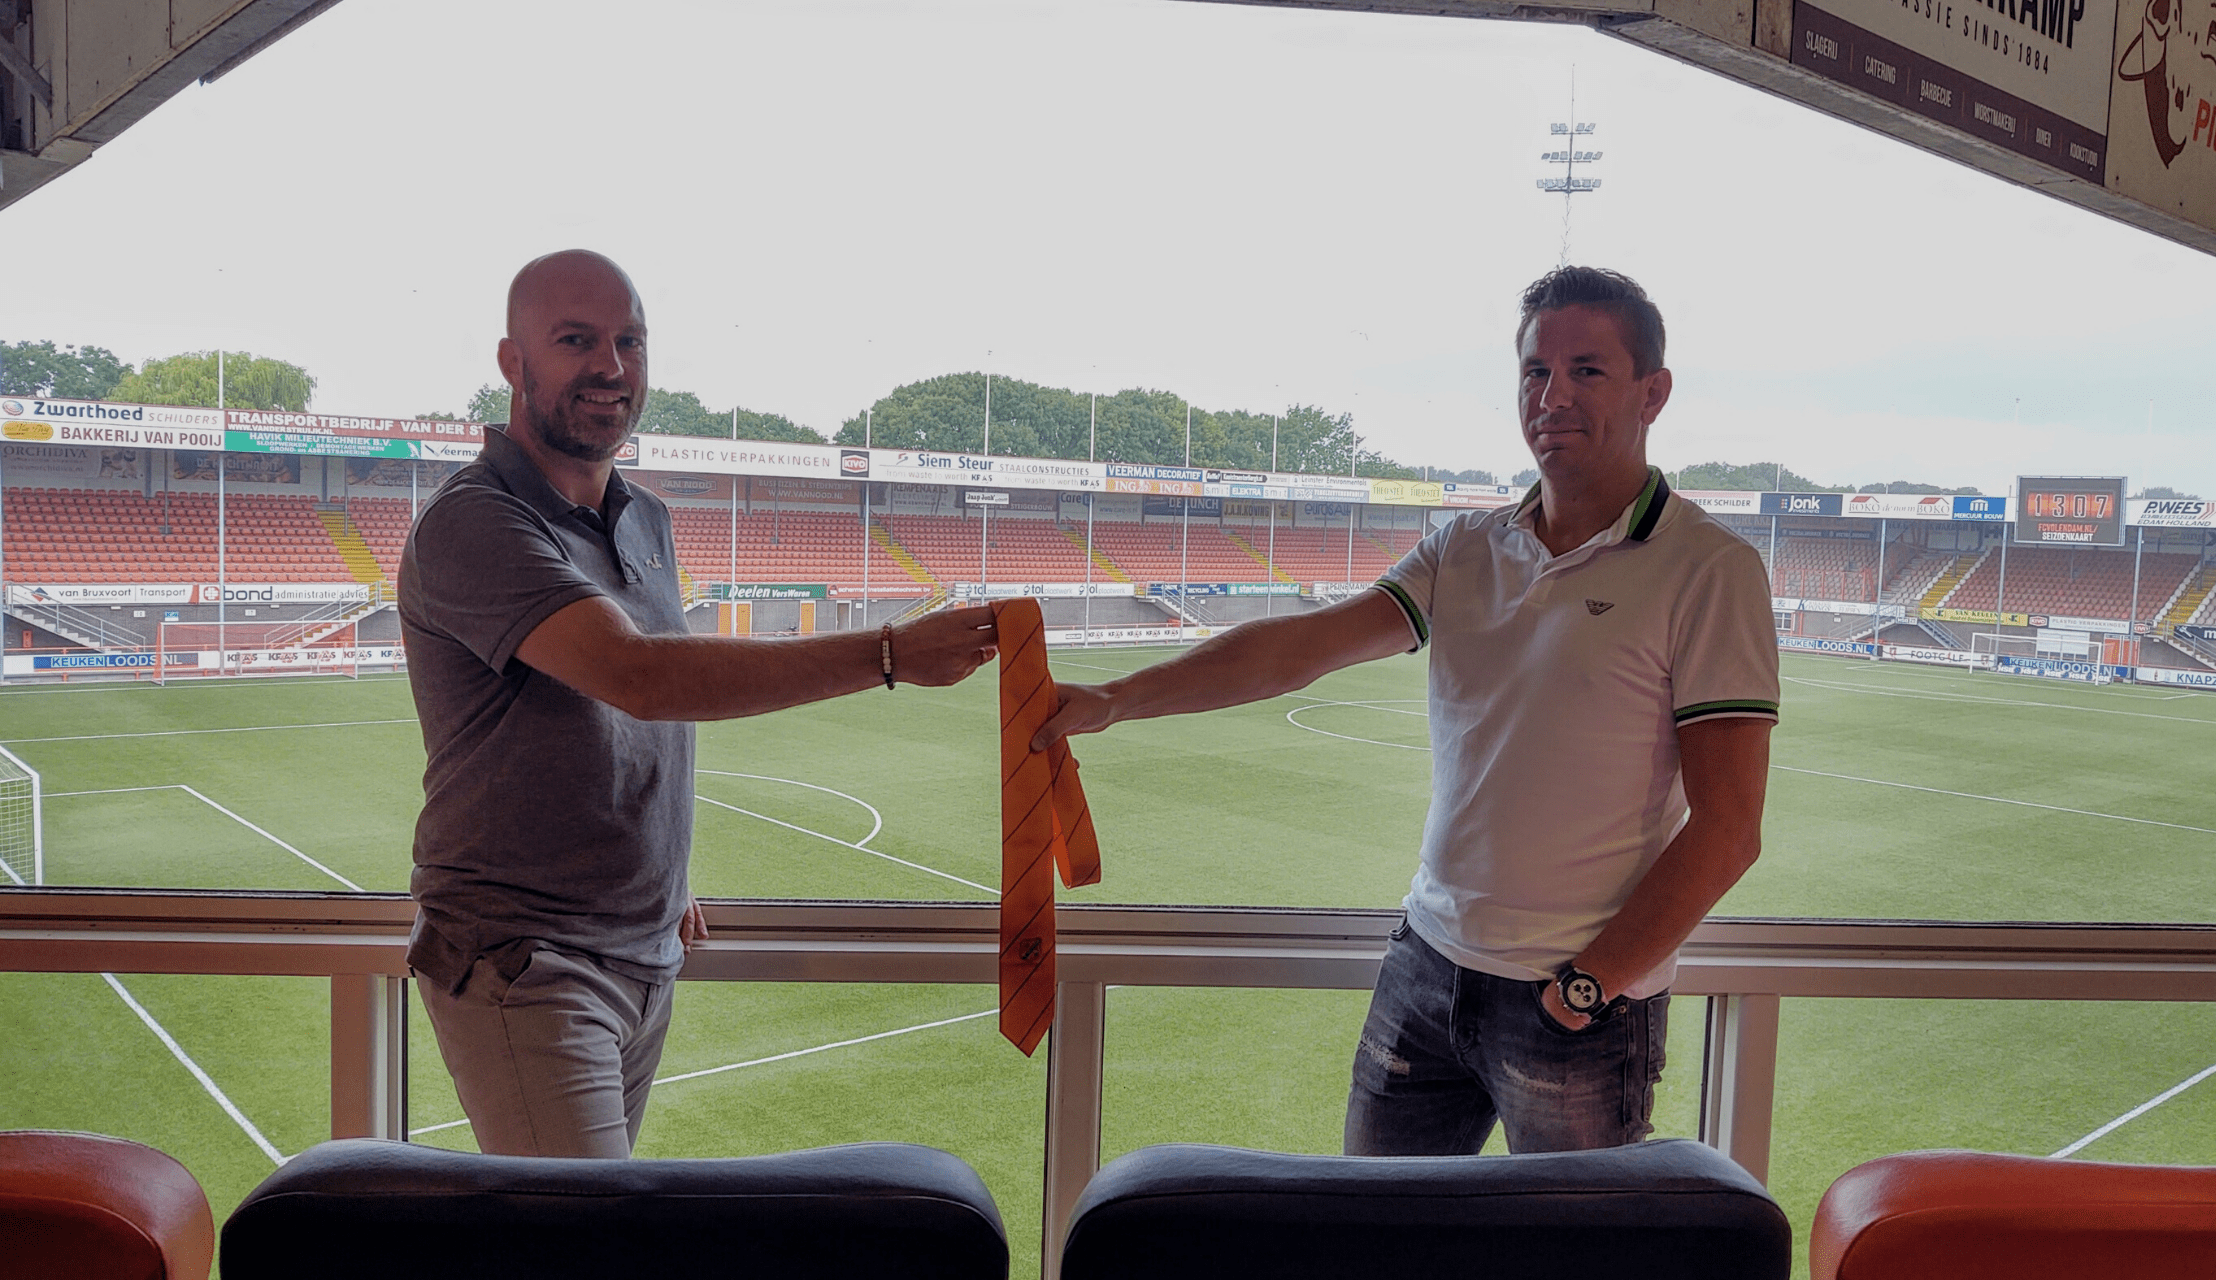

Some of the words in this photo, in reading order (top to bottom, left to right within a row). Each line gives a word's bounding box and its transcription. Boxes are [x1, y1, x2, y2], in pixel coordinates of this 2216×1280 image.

[1976, 0, 2085, 49] AMP
[1805, 30, 1839, 61] SLAGERIJ
[1963, 15, 2009, 56] SINDS
[2018, 42, 2049, 75] 1884
[1864, 55, 1897, 85] CATERING
[1919, 78, 1953, 108] BARBECUE
[2192, 97, 2216, 152] PI
[34, 401, 144, 421] Zwarthoed
[148, 412, 219, 425] SCHILDERS
[227, 411, 394, 432] TRANSPORTBEDRIJF
[400, 421, 432, 434] VAN
[435, 423, 465, 436] DER
[61, 426, 140, 444] BAKKERIJ
[144, 431, 174, 445] VAN
[179, 432, 222, 447] POOIJ
[249, 432, 282, 441] HAVIK
[284, 434, 370, 446] MILIEUTECHNIEK
[372, 439, 393, 447] B.V.
[652, 447, 715, 461] PLASTIC
[720, 451, 831, 468] VERPAKKINGEN
[844, 459, 867, 470] KIVO
[918, 453, 951, 468] Siem
[958, 456, 994, 471] Steur
[1000, 464, 1090, 476] STAALCONSTRUCTIES
[1108, 464, 1155, 478] VEERMAN
[1157, 469, 1202, 480] DECORATIEF
[660, 479, 681, 489] VAN
[683, 480, 713, 489] NOOD
[1115, 480, 1136, 492] ING
[1160, 483, 1180, 493] ING
[1232, 487, 1261, 496] ELEKTRA
[1061, 492, 1081, 503] Care
[1169, 498, 1182, 508] DE
[1849, 502, 1880, 512] BOKO
[1916, 504, 1950, 514] BOKO
[2042, 532, 2094, 542] SEIZOENKAART
[82, 588, 132, 597] Bruxvoort
[140, 588, 186, 598] Transport
[223, 586, 273, 601] bond
[274, 589, 336, 599] administratie
[728, 585, 771, 598] Deelen
[772, 588, 810, 597] VersWaren
[1031, 584, 1044, 594] tol
[1778, 637, 1869, 654] KEUKENLOODS.NL
